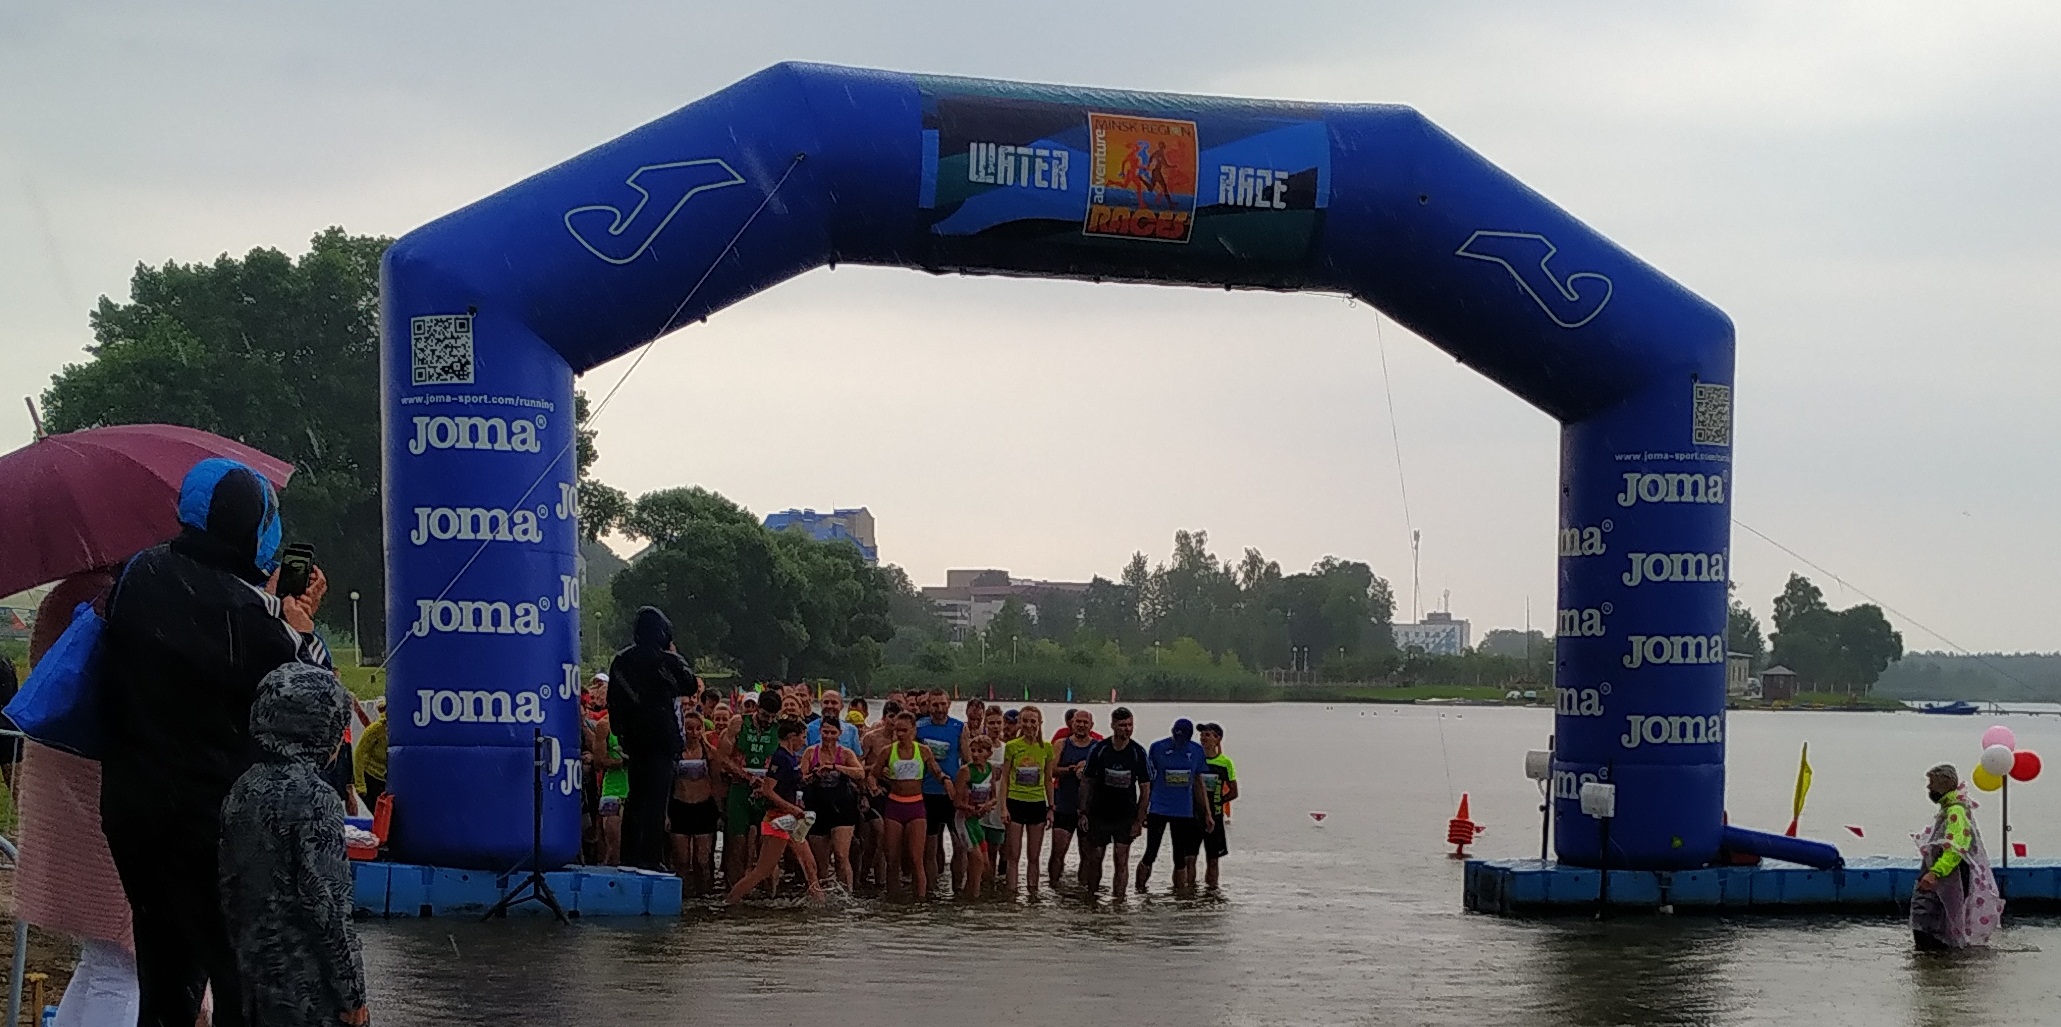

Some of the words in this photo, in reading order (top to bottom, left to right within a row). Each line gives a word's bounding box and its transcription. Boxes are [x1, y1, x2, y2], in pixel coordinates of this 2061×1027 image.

[1095, 119, 1137, 133] MINSK
[1140, 124, 1192, 137] REGION
[968, 142, 1069, 191] WATER
[1093, 129, 1107, 204] adventure
[1219, 165, 1290, 210] RACE
[1087, 204, 1190, 240] RACES
[400, 393, 555, 413] www.joma-sport.com/running
[1560, 526, 1607, 557] ma
[1558, 607, 1606, 638] ma
[1556, 687, 1604, 717] ma
[560, 758, 582, 796] Jo
